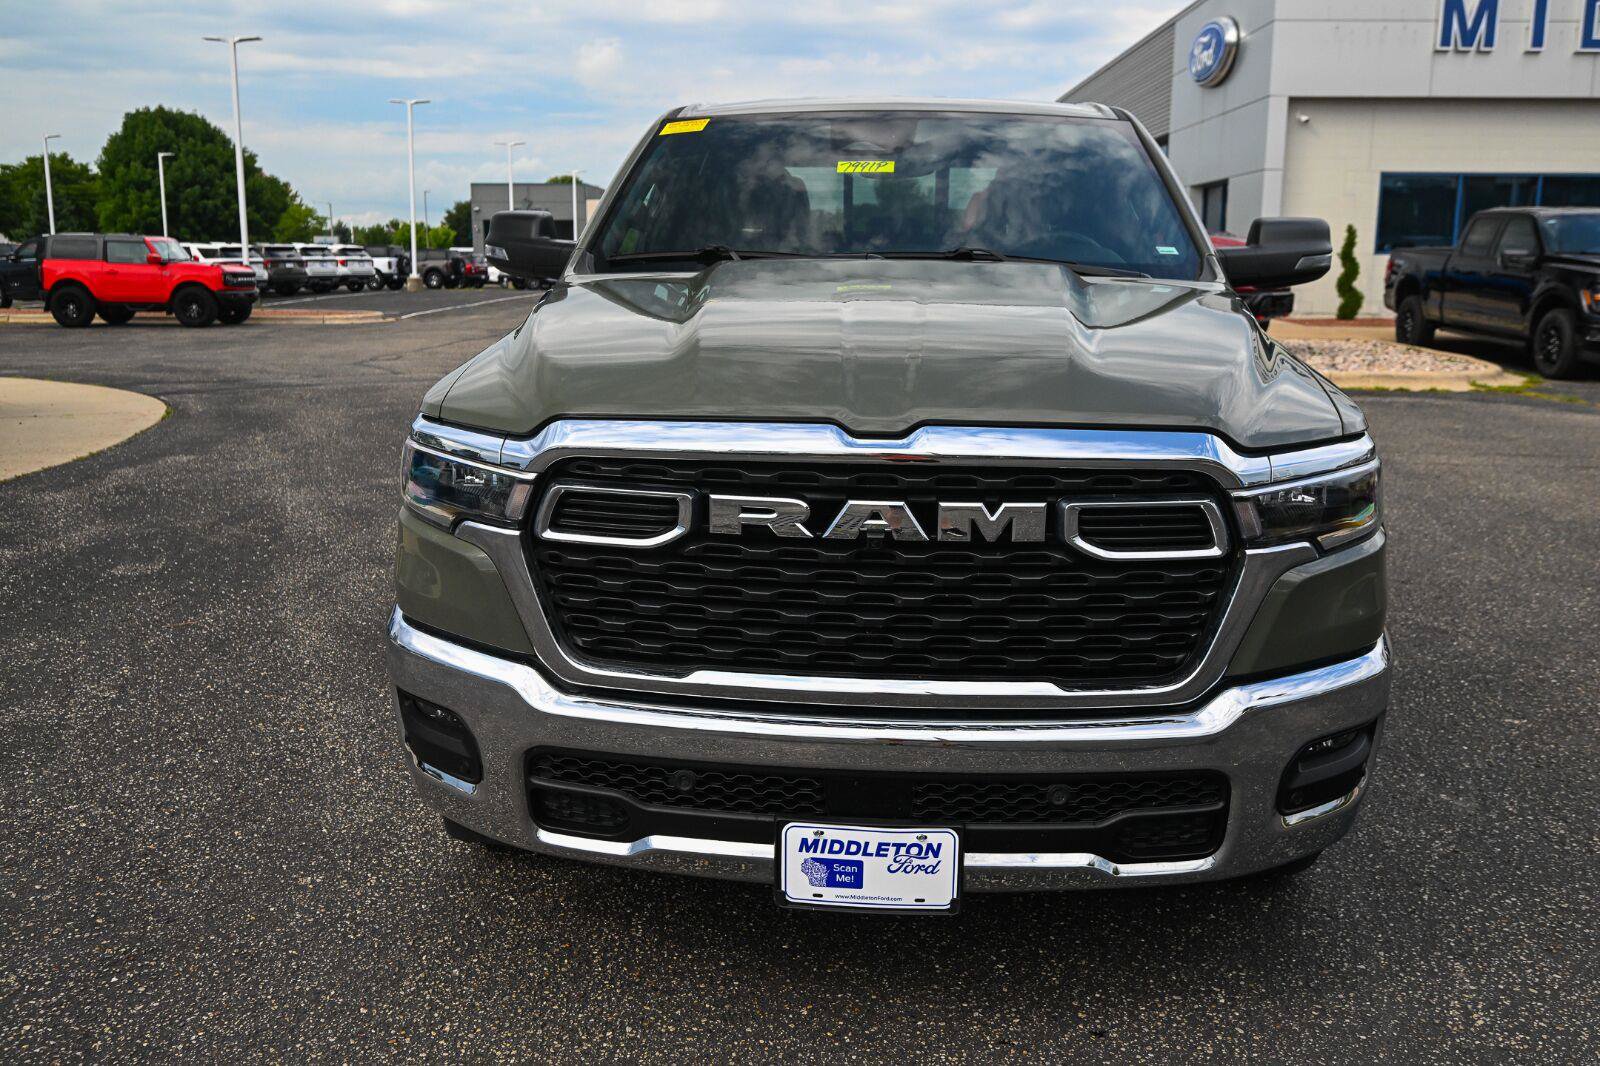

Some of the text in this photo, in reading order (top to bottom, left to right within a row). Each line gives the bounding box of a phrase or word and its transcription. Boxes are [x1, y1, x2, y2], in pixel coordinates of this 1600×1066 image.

[708, 494, 1048, 542] RAM
[798, 837, 943, 859] MIDDLETON
[833, 863, 858, 873] Scan
[886, 854, 942, 875] Ford
[836, 874, 855, 883] Me!
